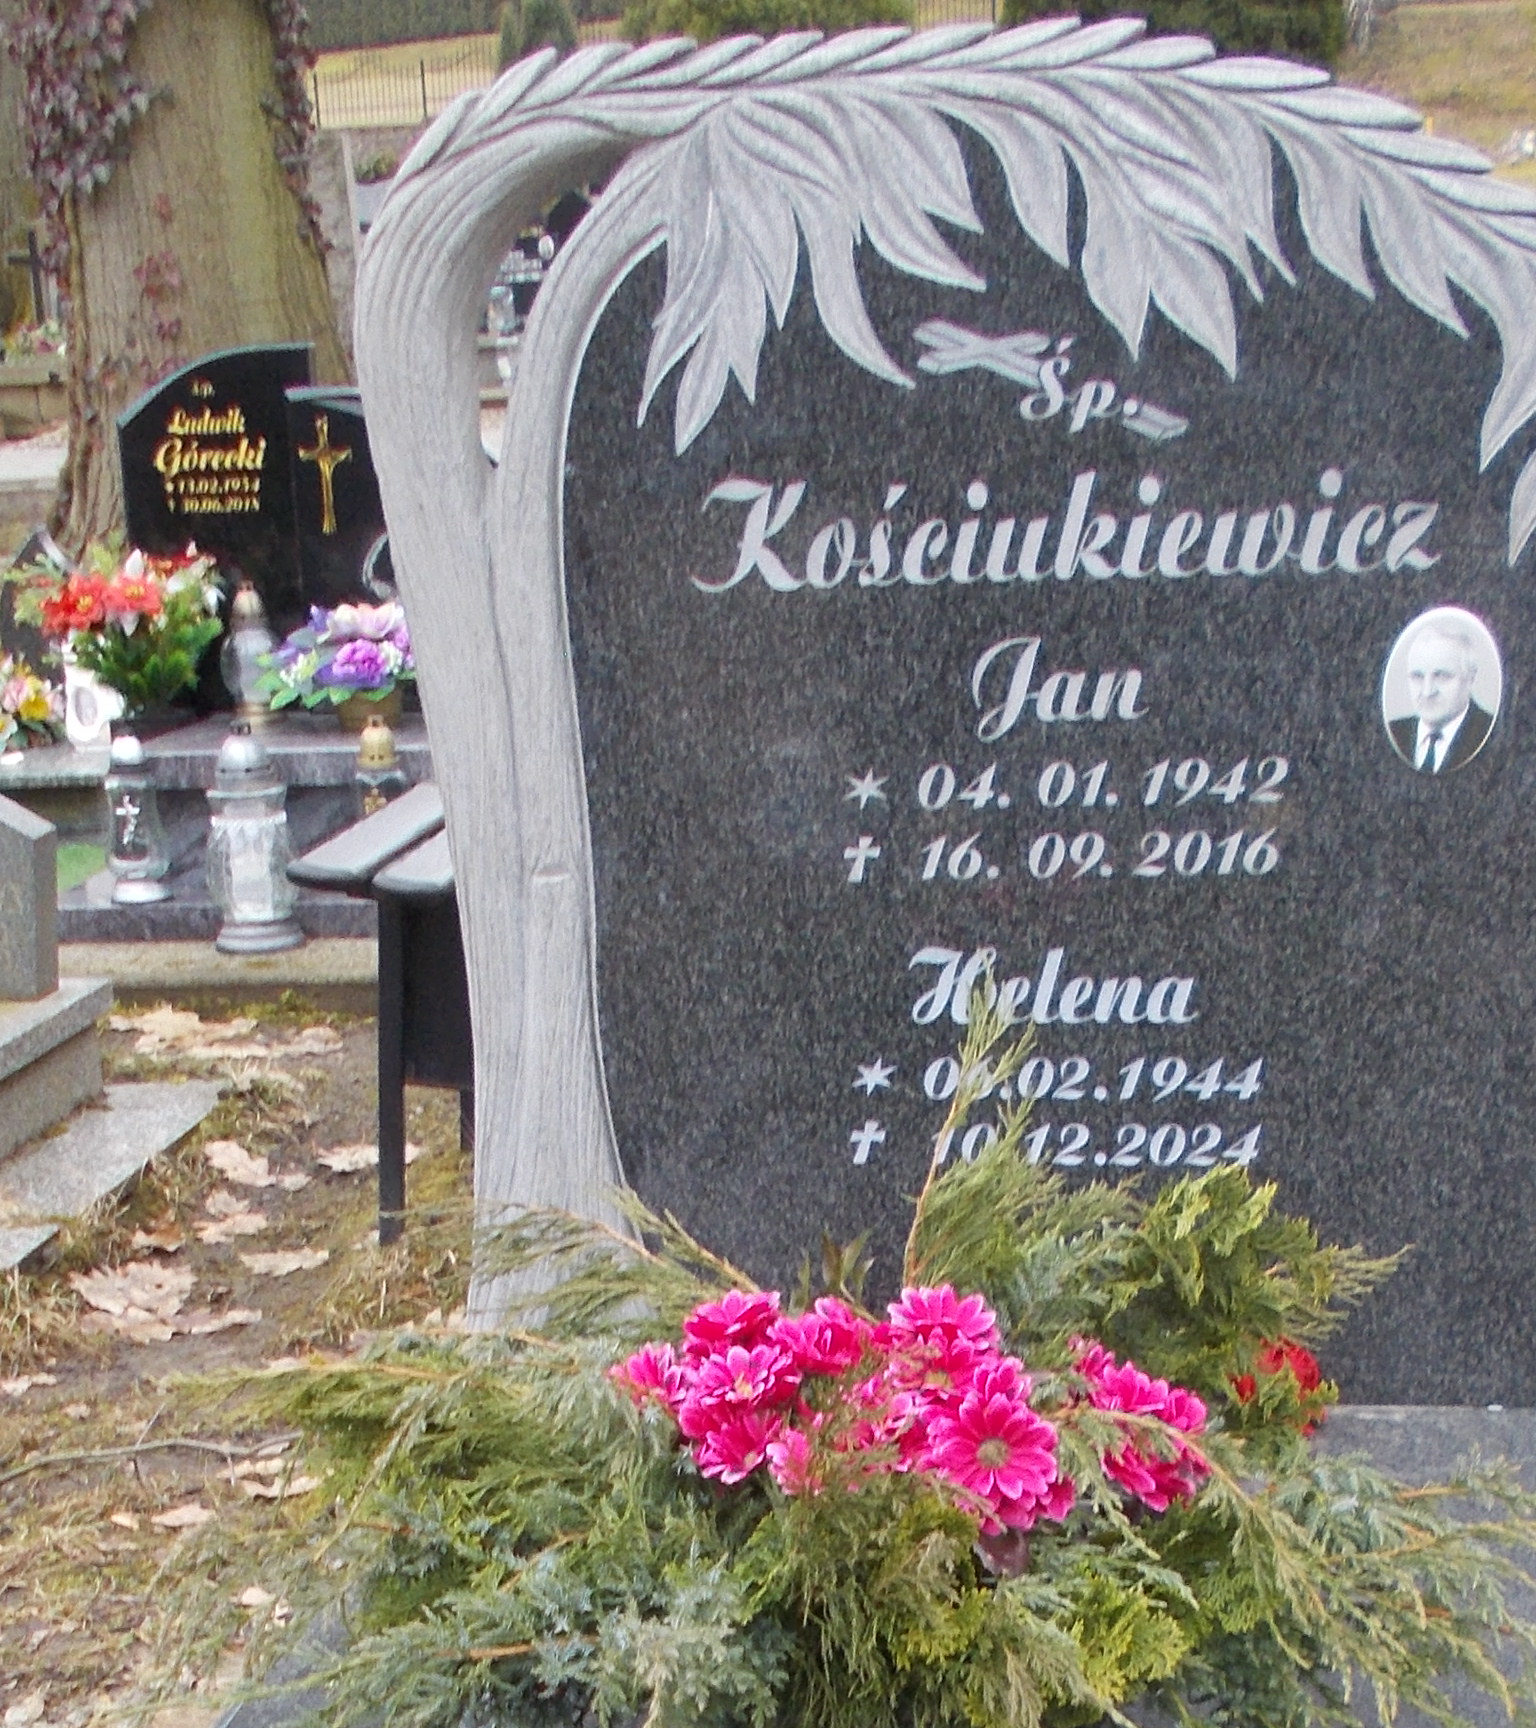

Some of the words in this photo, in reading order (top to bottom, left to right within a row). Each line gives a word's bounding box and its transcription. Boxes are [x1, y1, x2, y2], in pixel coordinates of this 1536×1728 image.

[1020, 337, 1138, 434] Śp.
[167, 406, 246, 434] Ludwik
[153, 436, 267, 478] Górecki
[692, 467, 1442, 594] Kościukiewicz
[972, 635, 1149, 743] Jan
[918, 762, 1011, 811] 04.
[1038, 758, 1120, 808] 01.
[1143, 755, 1290, 807] 1942
[921, 831, 1000, 881] 16.
[1028, 832, 1114, 880] 09.
[1132, 827, 1280, 878] 2016
[908, 945, 1199, 1025] Helena
[931, 1121, 1263, 1167] 1012.2024
